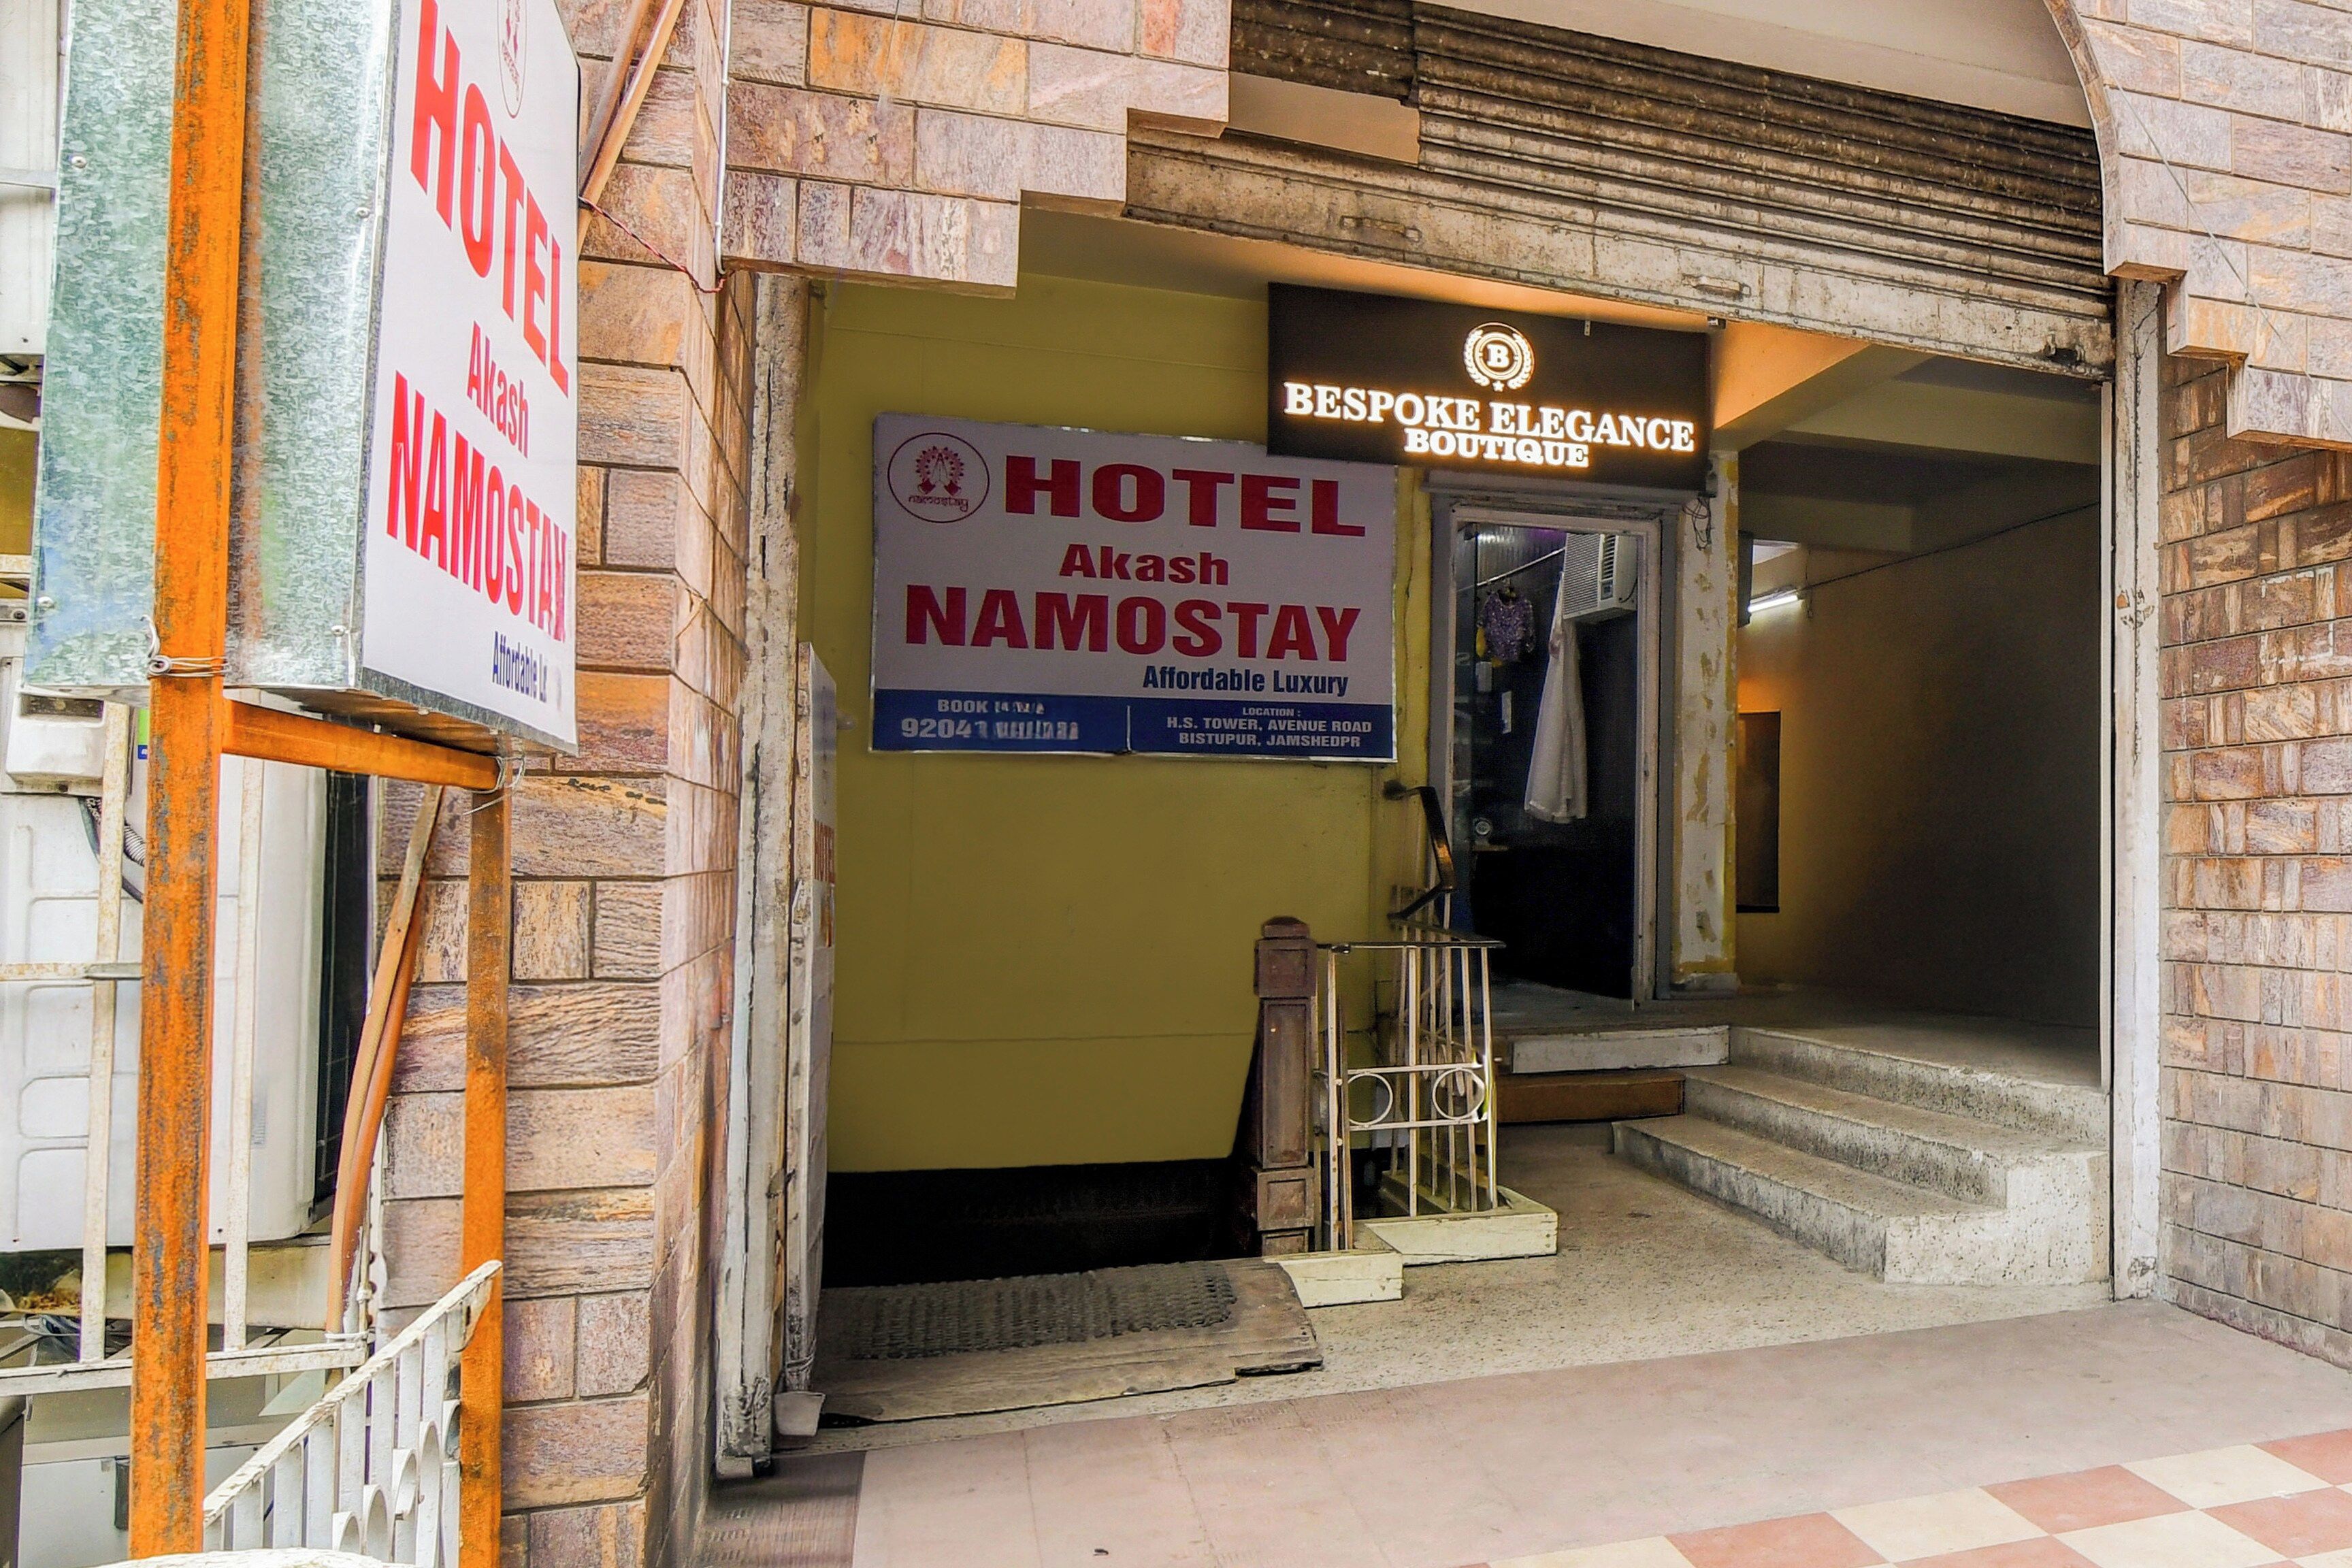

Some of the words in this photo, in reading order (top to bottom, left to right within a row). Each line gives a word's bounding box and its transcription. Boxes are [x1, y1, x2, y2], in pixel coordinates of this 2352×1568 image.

[410, 0, 569, 399] HOTEL
[1486, 344, 1509, 368] B
[466, 320, 529, 459] Akash
[1283, 381, 1481, 430] BESPOKE
[1488, 401, 1695, 453] ELEGANCE
[1403, 427, 1590, 468] BOUTIQUE
[1005, 455, 1366, 537] HOTEL
[1059, 544, 1229, 585] Akash
[905, 584, 1361, 662] NAMOSTAY
[492, 630, 538, 700] Affordable
[1143, 666, 1266, 692] Affordable
[1273, 670, 1350, 698] Luxury
[937, 699, 989, 713] BOOK
[1167, 717, 1198, 729] H.S.
[1203, 717, 1262, 732] TOWER,
[1268, 719, 1326, 732] AVENUE
[1331, 721, 1372, 733] ROAD
[1243, 707, 1294, 717] LOCATION
[1179, 732, 1261, 747] BISTUPUR,
[1266, 734, 1361, 747] JAMSHEDPR
